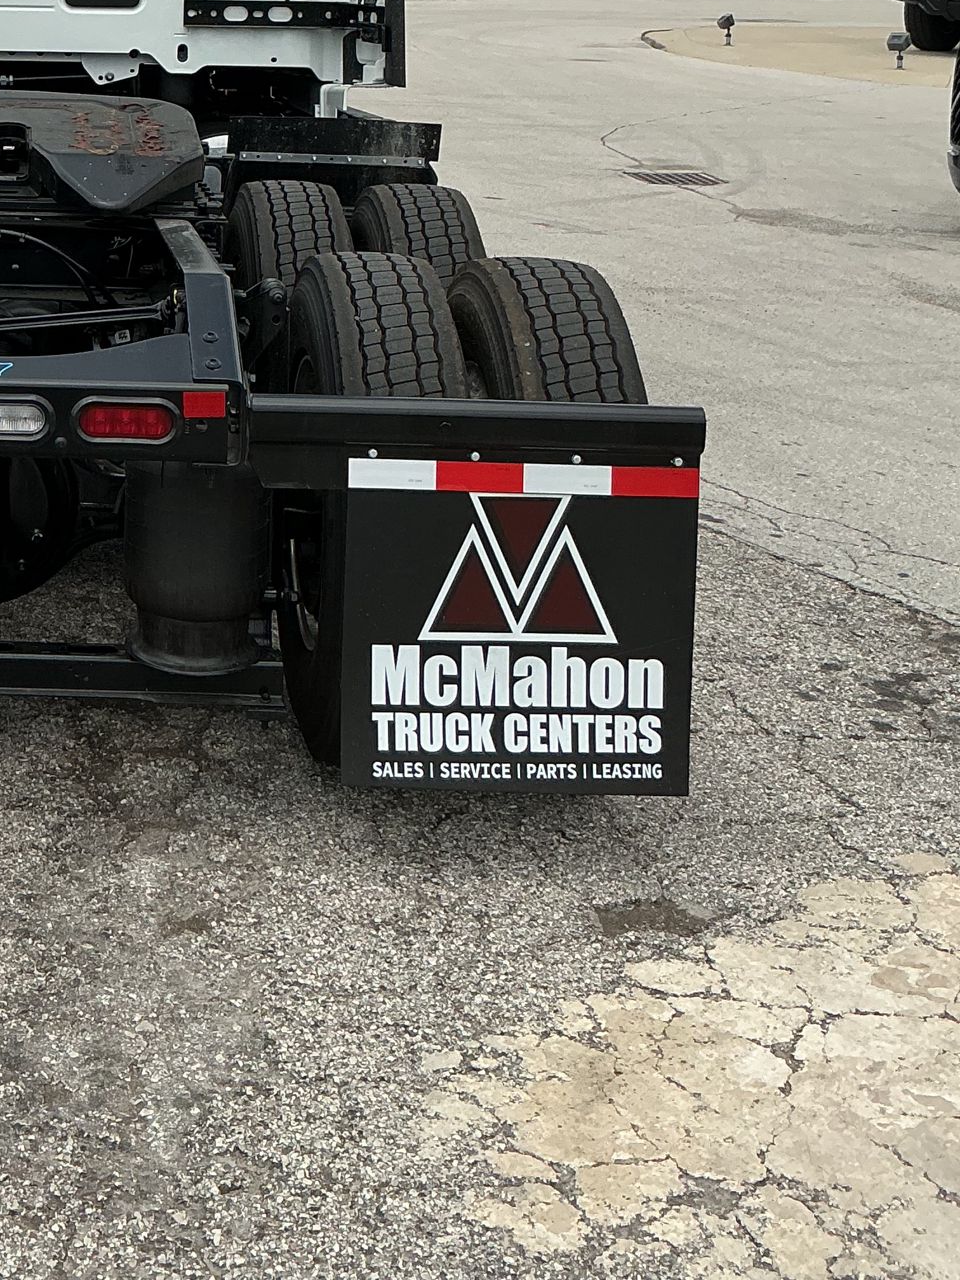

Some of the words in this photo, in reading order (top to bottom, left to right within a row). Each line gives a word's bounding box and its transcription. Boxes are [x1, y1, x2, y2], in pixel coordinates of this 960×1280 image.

[371, 644, 665, 710] McMahon
[371, 711, 497, 753] TRUCK
[503, 712, 663, 755] CENTERS
[372, 761, 425, 779] SALES
[440, 761, 512, 780] SERVICE
[526, 763, 578, 780] PARTS
[592, 763, 663, 780] LEASING
